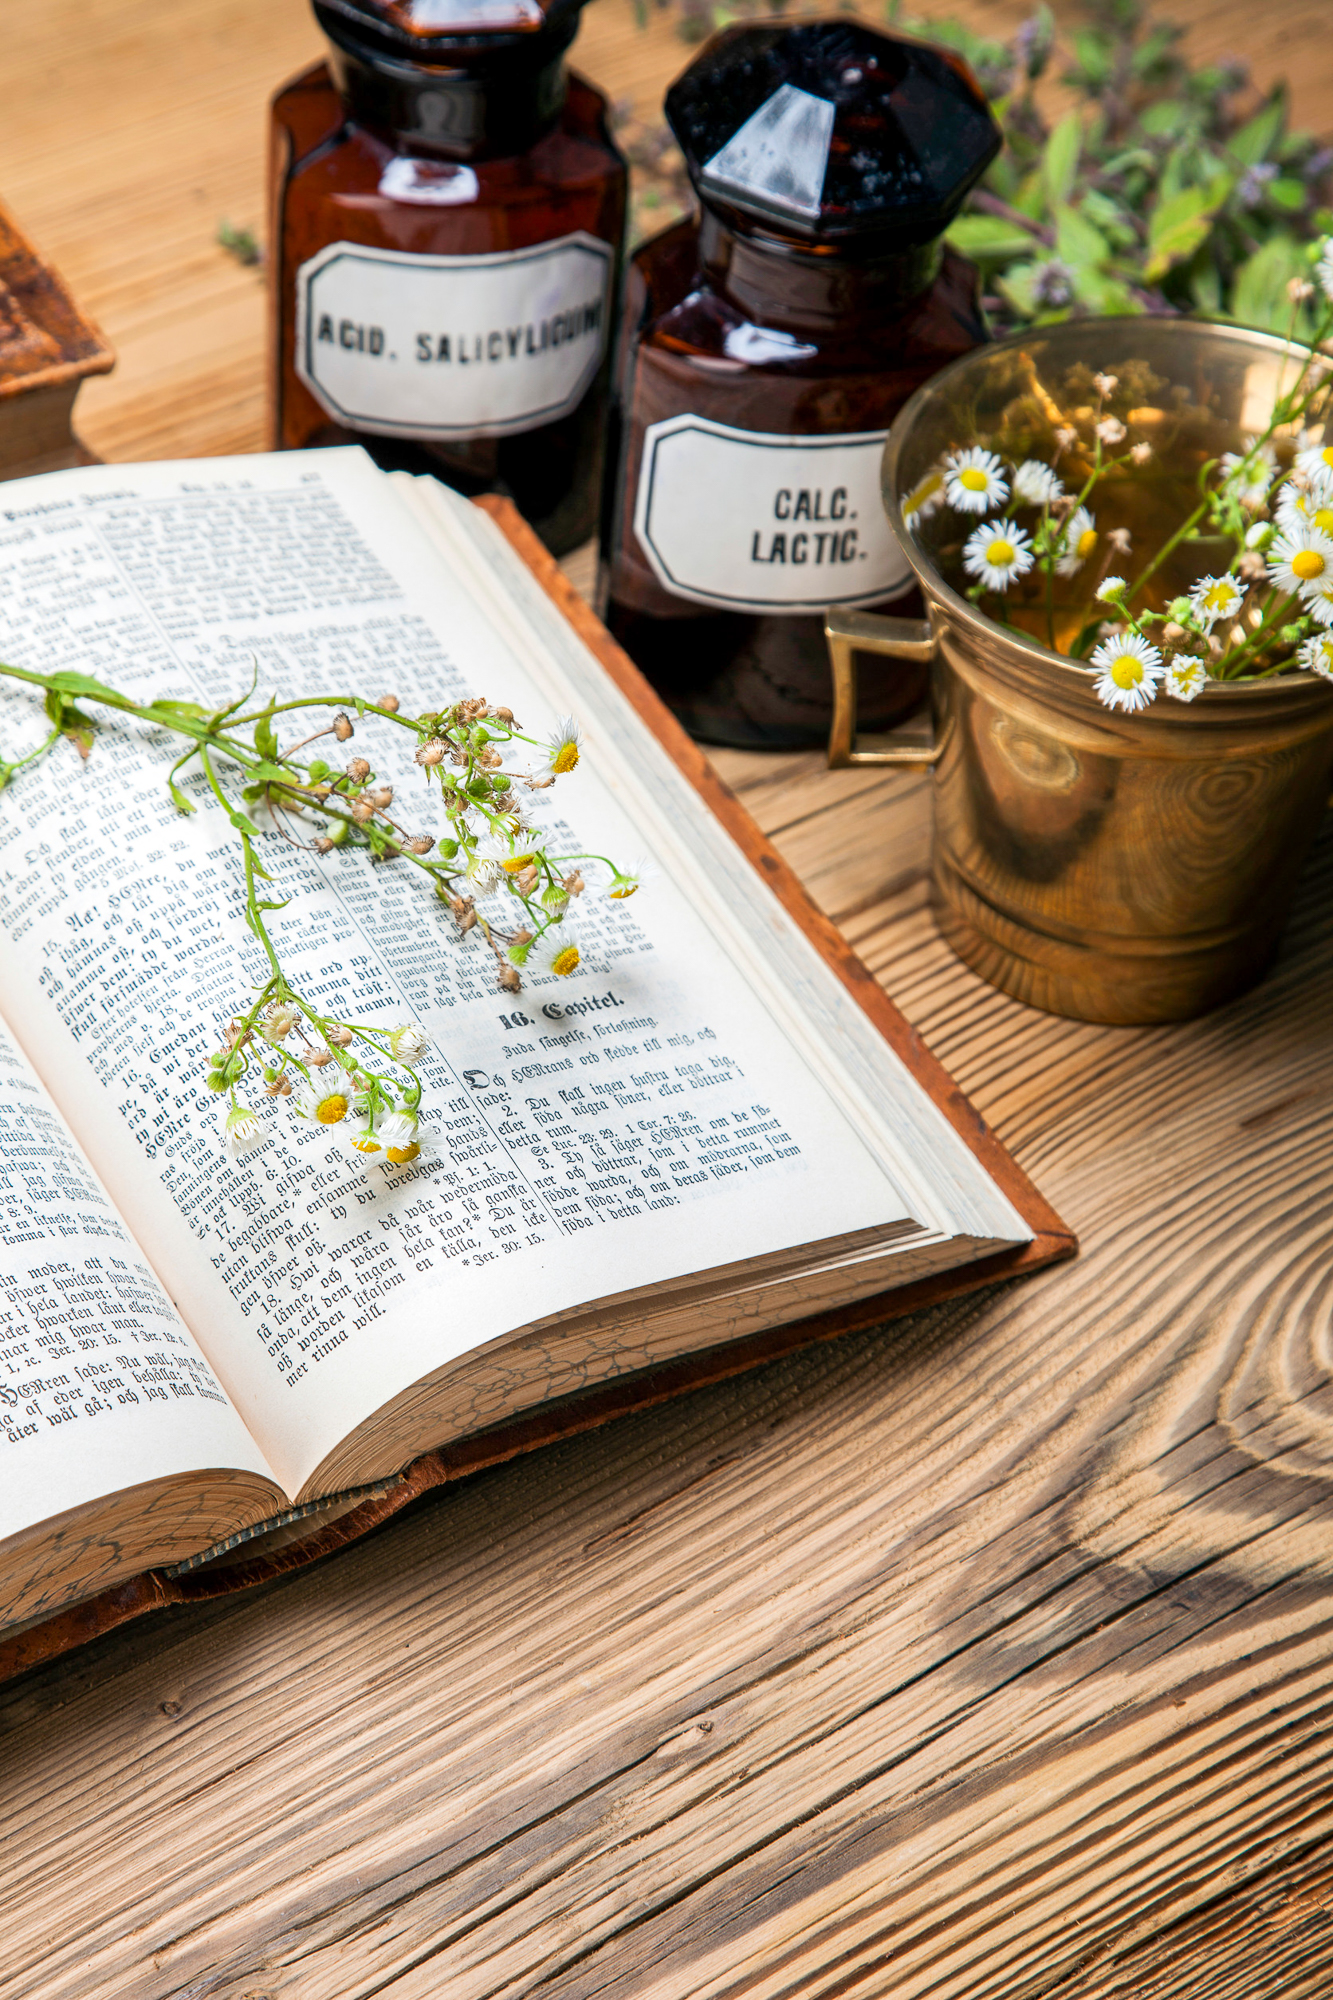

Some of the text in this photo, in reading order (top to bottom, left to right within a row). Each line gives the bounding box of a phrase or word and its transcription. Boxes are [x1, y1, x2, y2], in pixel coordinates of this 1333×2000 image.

[317, 313, 398, 357] ACID.
[774, 486, 858, 520] CALC.
[752, 528, 868, 565] LACTIC.
[499, 992, 624, 1029] 16. Capitel.
[579, 1052, 599, 1065] ord
[644, 1039, 661, 1051] till
[697, 1027, 716, 1039] och
[498, 1121, 526, 1135] eller
[533, 1111, 562, 1127] föda
[571, 1101, 609, 1115] några
[659, 1083, 684, 1096] eller
[688, 1072, 732, 1088] döttrar
[502, 1105, 517, 1117] 2.
[525, 1098, 550, 1111] Du
[590, 1081, 626, 1095] ingen
[675, 1064, 703, 1076] taga
[505, 1125, 577, 1149] detta rum.
[534, 1176, 556, 1189] ner
[566, 1166, 586, 1179] och
[592, 1156, 641, 1172] döttrar,
[682, 1144, 689, 1152] i
[696, 1134, 729, 1148] detta
[734, 1119, 781, 1138] rummet
[538, 1159, 554, 1169] 3.
[709, 1118, 729, 1129] om
[731, 1112, 749, 1122] de
[579, 1133, 597, 1144] 23:
[599, 1129, 617, 1139] 29.
[626, 1124, 635, 1133] 1
[663, 1116, 676, 1124] 7:
[678, 1111, 696, 1121] 26.
[211, 1253, 225, 1269] de
[311, 1170, 340, 1191] eller
[444, 1113, 482, 1131] dem;
[542, 1186, 579, 1205] födde
[586, 1174, 631, 1191] warda,
[641, 1164, 661, 1178] och
[669, 1161, 689, 1171] om
[698, 1142, 762, 1164] mödrarna,
[552, 1204, 581, 1217] dem
[585, 1194, 622, 1211] föda;
[626, 1185, 645, 1199] och
[650, 1182, 670, 1192] om
[672, 1171, 708, 1186] deras
[710, 1163, 747, 1180] fäder,
[777, 1146, 802, 1161] dem
[216, 1221, 235, 1241] 17.
[276, 1165, 315, 1196] gifwa
[331, 1206, 346, 1219] ty
[354, 1190, 376, 1204] du
[562, 1195, 680, 1235] föda i detta land:
[84, 1258, 103, 1269] att
[222, 1256, 248, 1283] utan
[251, 1220, 293, 1254] blifwa
[241, 1291, 260, 1316] gen
[262, 1257, 299, 1289] öfwer
[466, 1167, 479, 1176] 1:
[483, 1162, 496, 1171] 1.
[261, 1295, 281, 1314] 18.
[328, 1231, 372, 1261] warar
[378, 1213, 399, 1230] då
[404, 1200, 435, 1219] wår
[440, 1171, 517, 1203] wedermöda
[501, 1242, 521, 1253] 30:
[526, 1233, 544, 1245] 15.
[268, 1328, 299, 1357] onda,
[301, 1305, 320, 1326] att
[321, 1285, 352, 1308] dem
[355, 1258, 397, 1285] ingen
[404, 1239, 434, 1259] hela
[489, 1207, 515, 1221] Du
[520, 1198, 536, 1211] är
[273, 1294, 313, 1325] länge,
[321, 1267, 342, 1288] och
[350, 1242, 389, 1267] wåra
[428, 1211, 452, 1227] äro
[297, 1311, 345, 1351] worden
[416, 1259, 433, 1271] en
[442, 1238, 481, 1258] källa,
[489, 1224, 516, 1238] den
[524, 1212, 547, 1227] icke
[69, 1319, 143, 1337] hwar man.
[286, 1303, 386, 1387] mer rinna will.
[46, 1389, 139, 1426] wäl gå; och
[54, 1388, 83, 1405] eder
[93, 1378, 124, 1394] igen
